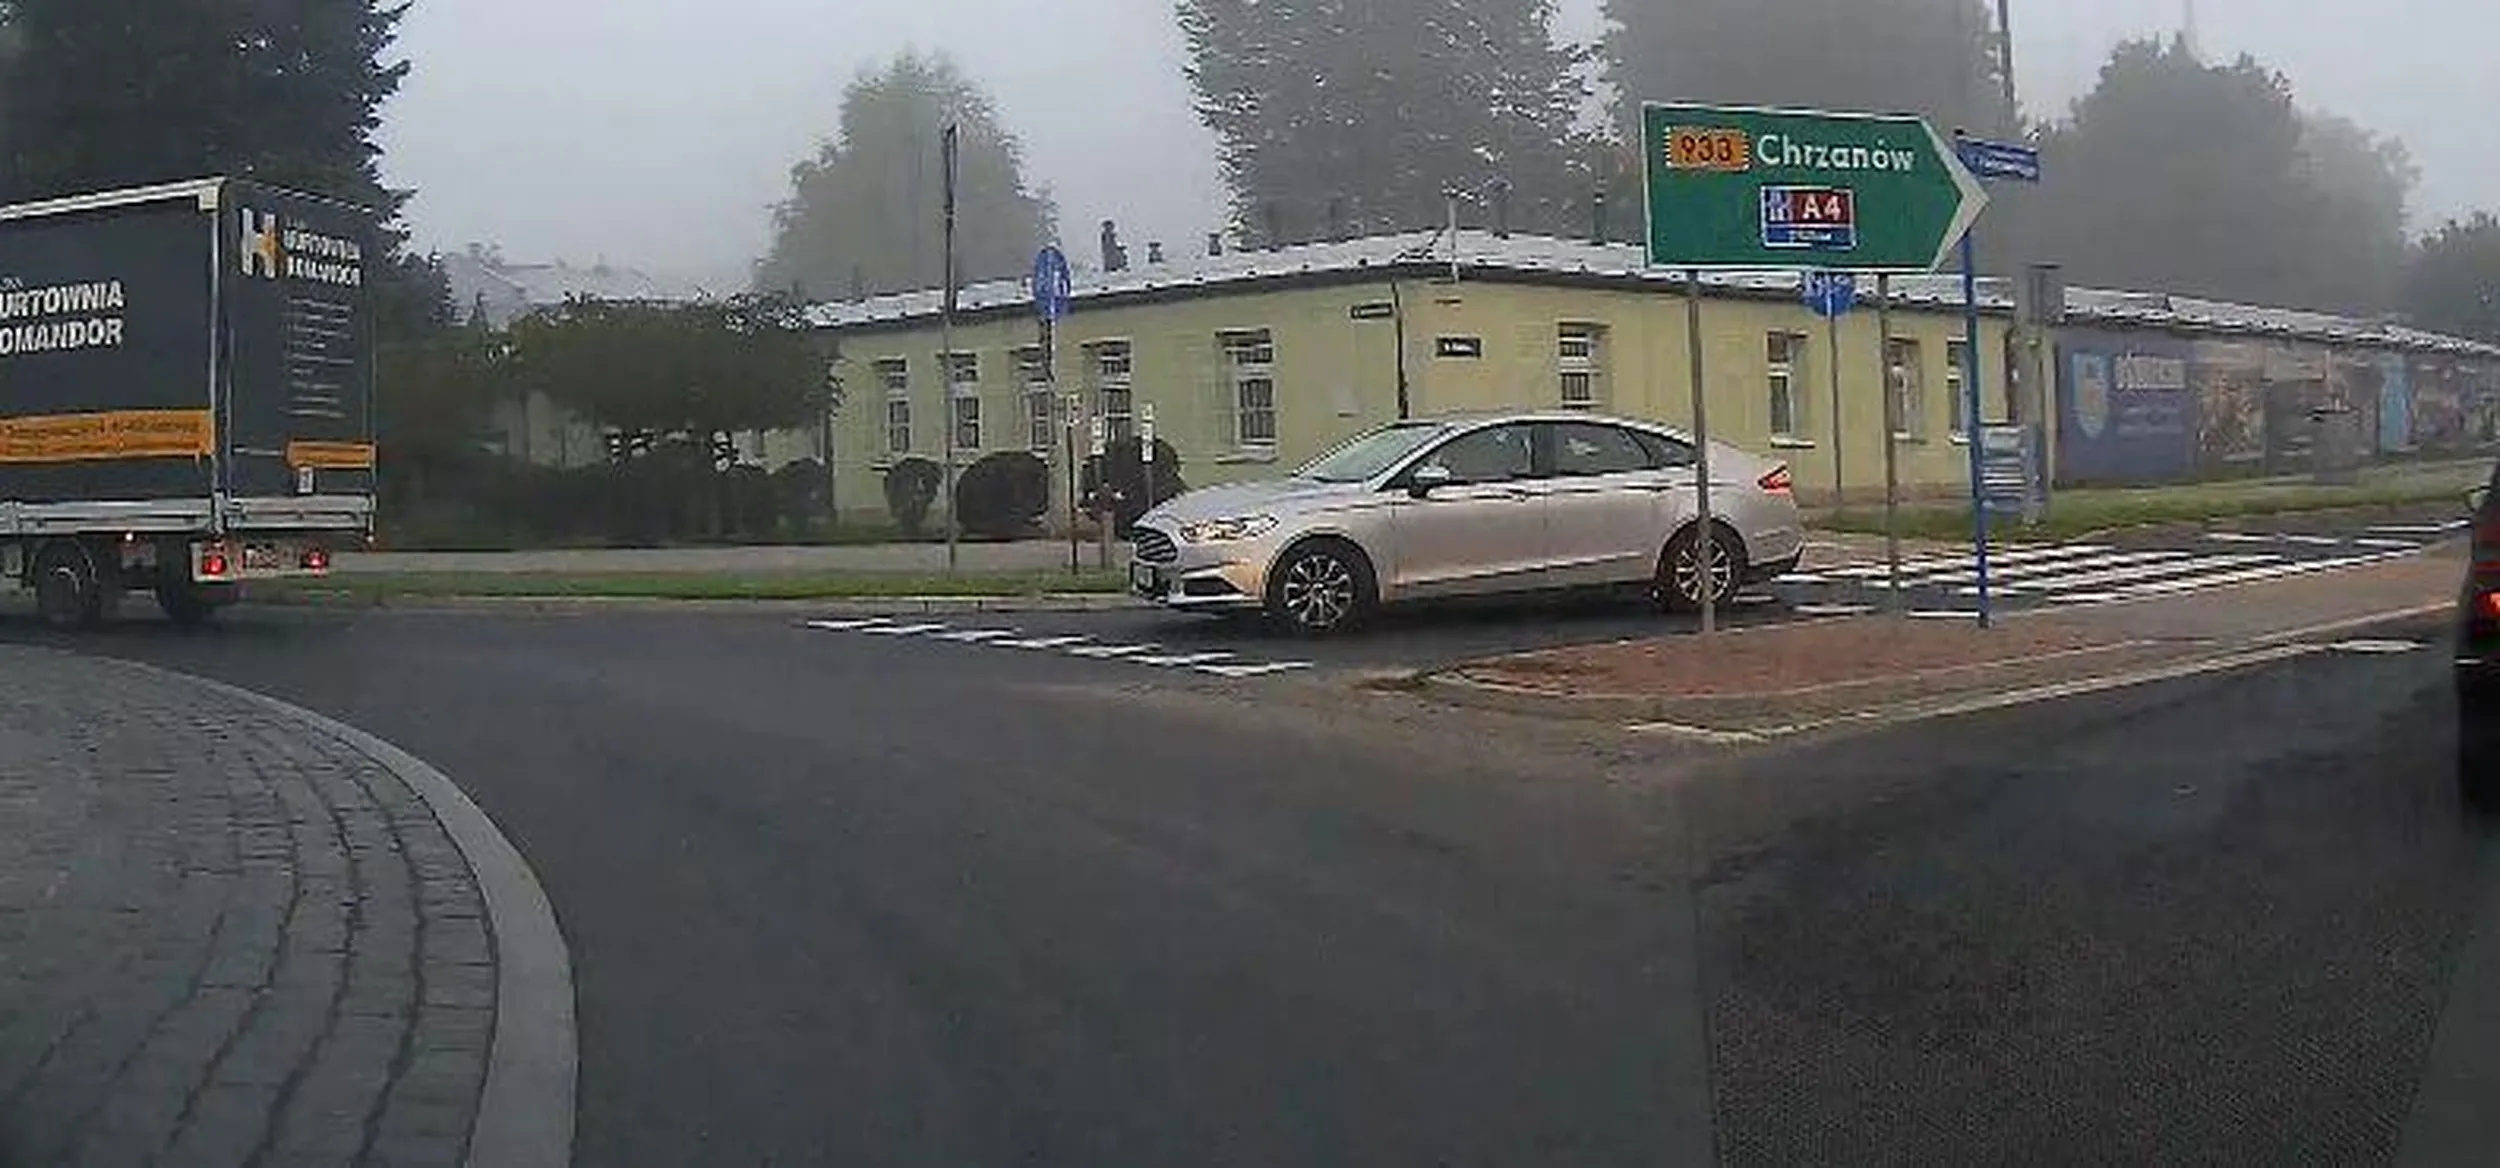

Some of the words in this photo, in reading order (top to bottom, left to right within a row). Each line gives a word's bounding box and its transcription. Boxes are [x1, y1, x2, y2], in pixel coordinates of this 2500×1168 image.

[1680, 135, 1732, 162] 933
[1757, 134, 1914, 171] Chrzanów
[1802, 193, 1842, 220] A4
